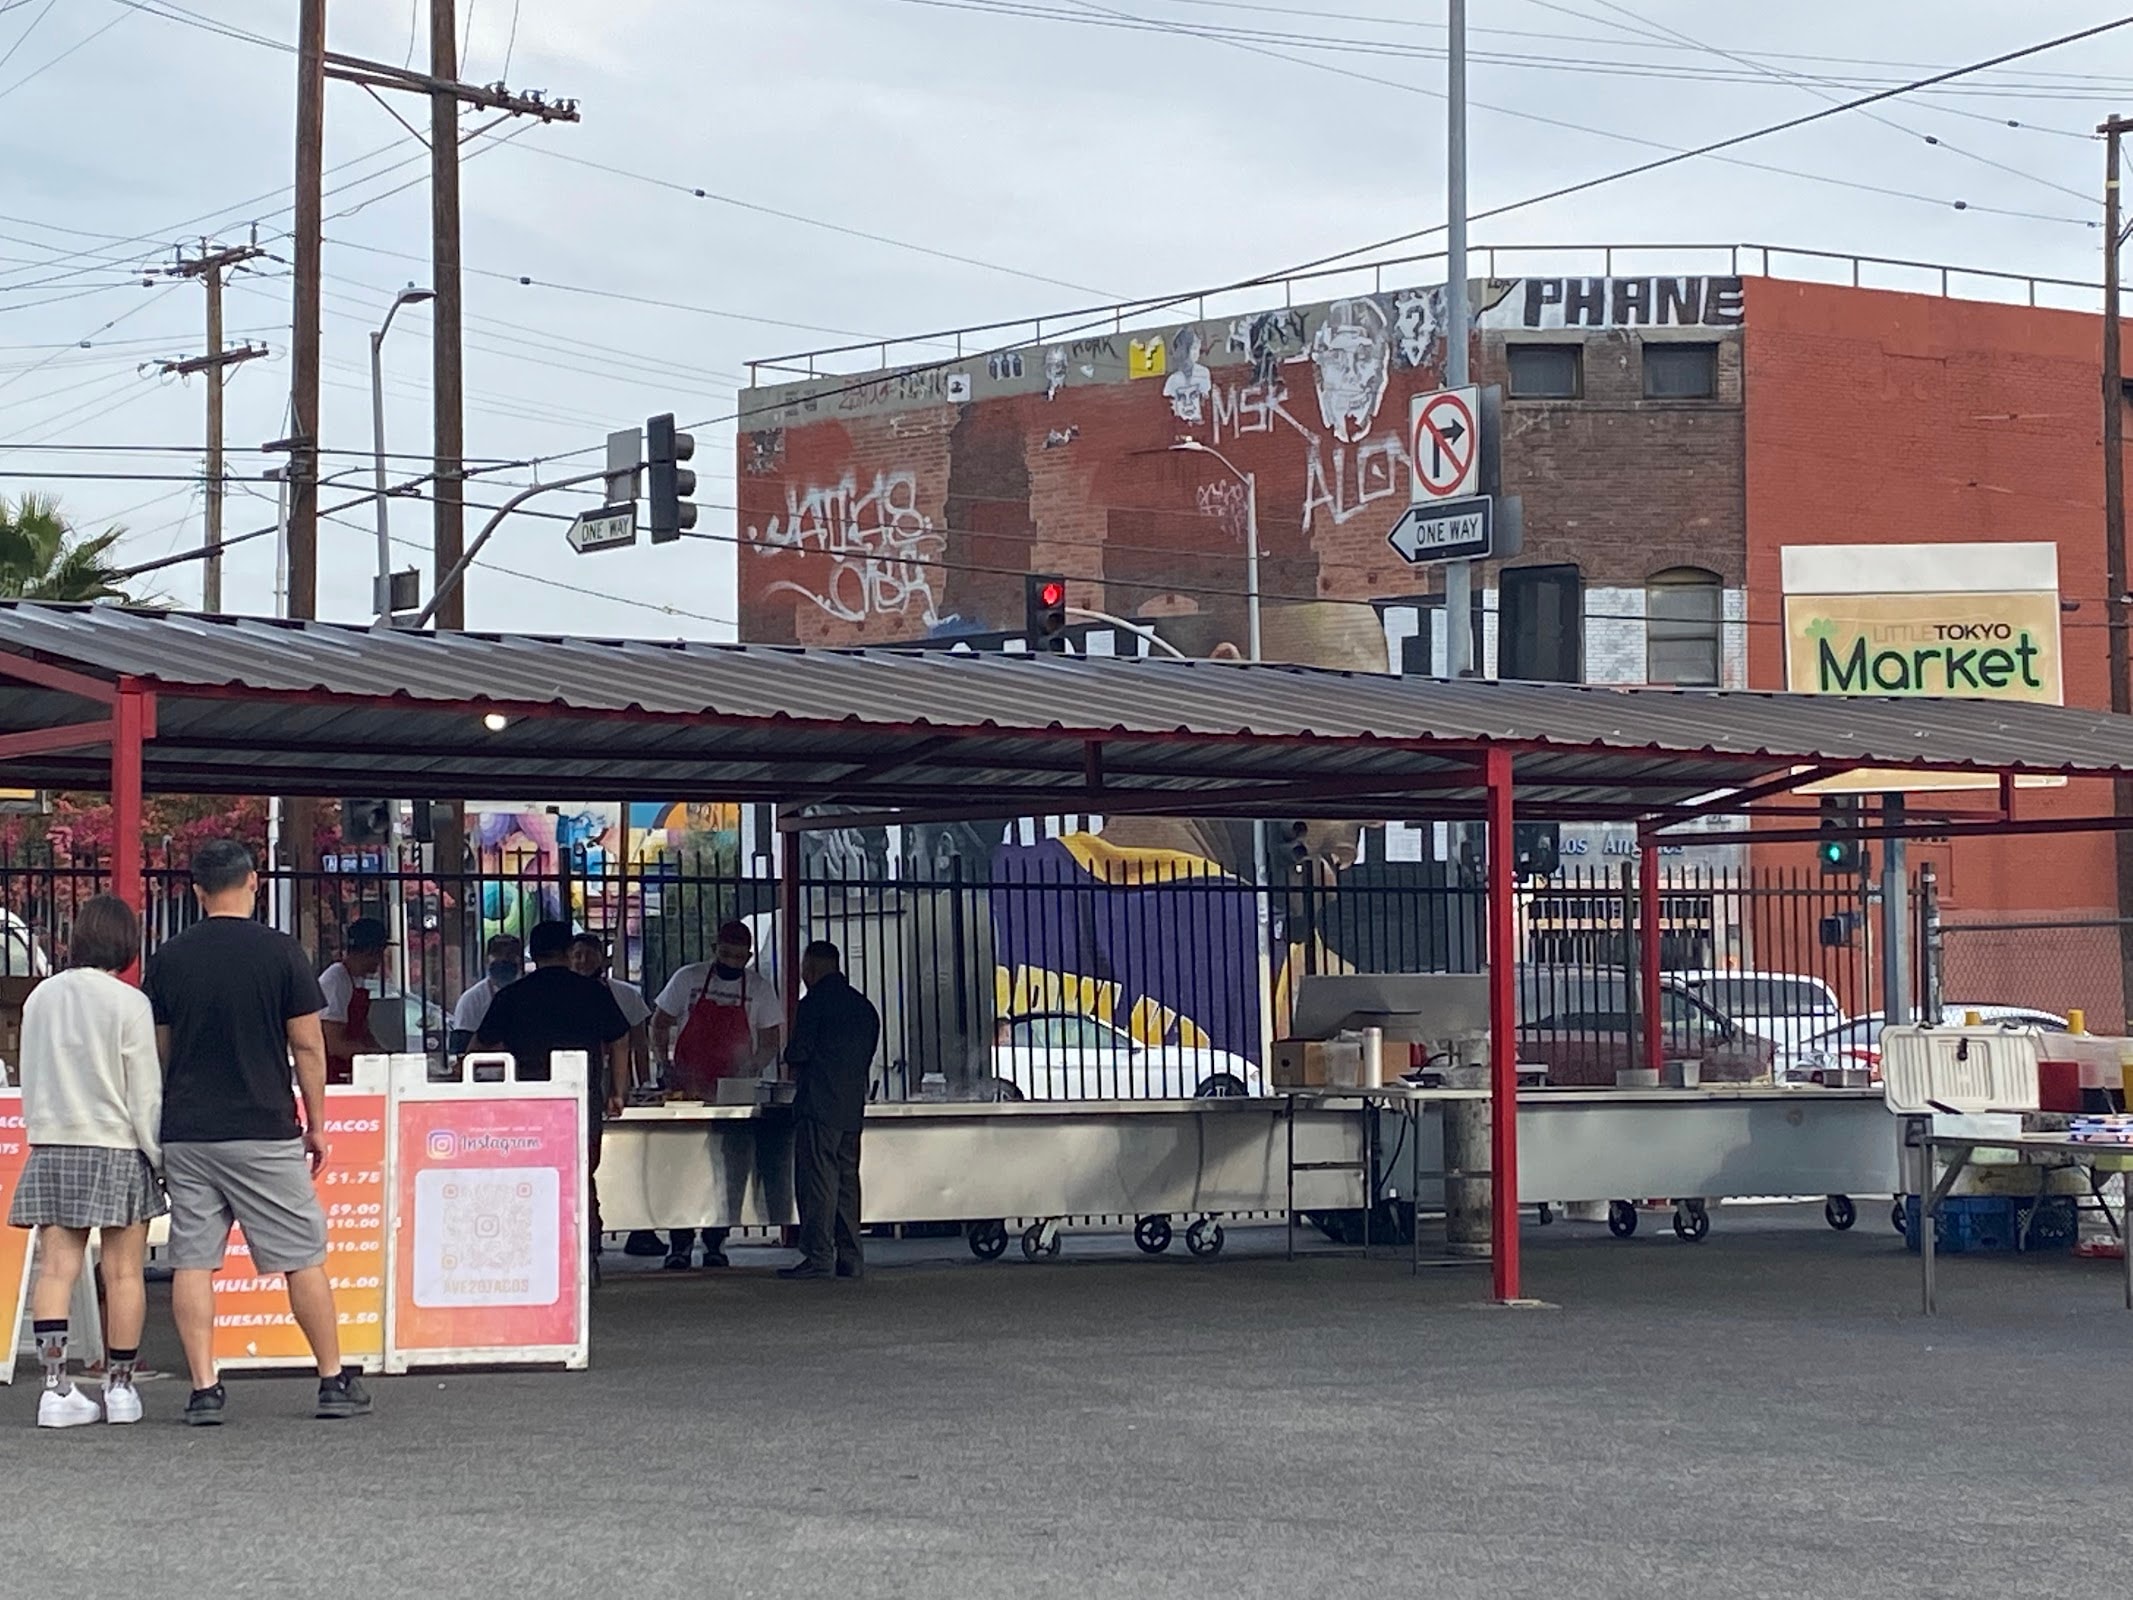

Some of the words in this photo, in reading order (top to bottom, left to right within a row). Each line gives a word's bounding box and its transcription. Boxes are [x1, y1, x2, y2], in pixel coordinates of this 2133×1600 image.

[1524, 278, 1744, 327] PHANE
[581, 520, 603, 542] ONE
[609, 516, 630, 536] WAY
[1416, 522, 1446, 545] ONE
[1449, 517, 1478, 541] WAY
[1873, 624, 1935, 643] LITTLE
[1933, 623, 2012, 641] TOKYO
[1818, 633, 2041, 692] Market
[324, 1119, 379, 1133] TACOS
[460, 1133, 541, 1155] Instagram
[325, 1171, 380, 1185] $1.75
[329, 1203, 380, 1216] $9.00
[326, 1217, 379, 1230] $10.00
[326, 1241, 379, 1253] $10.00
[212, 1277, 287, 1293] MULITA
[329, 1276, 380, 1290] $6.00
[337, 1312, 379, 1325] 2.50
